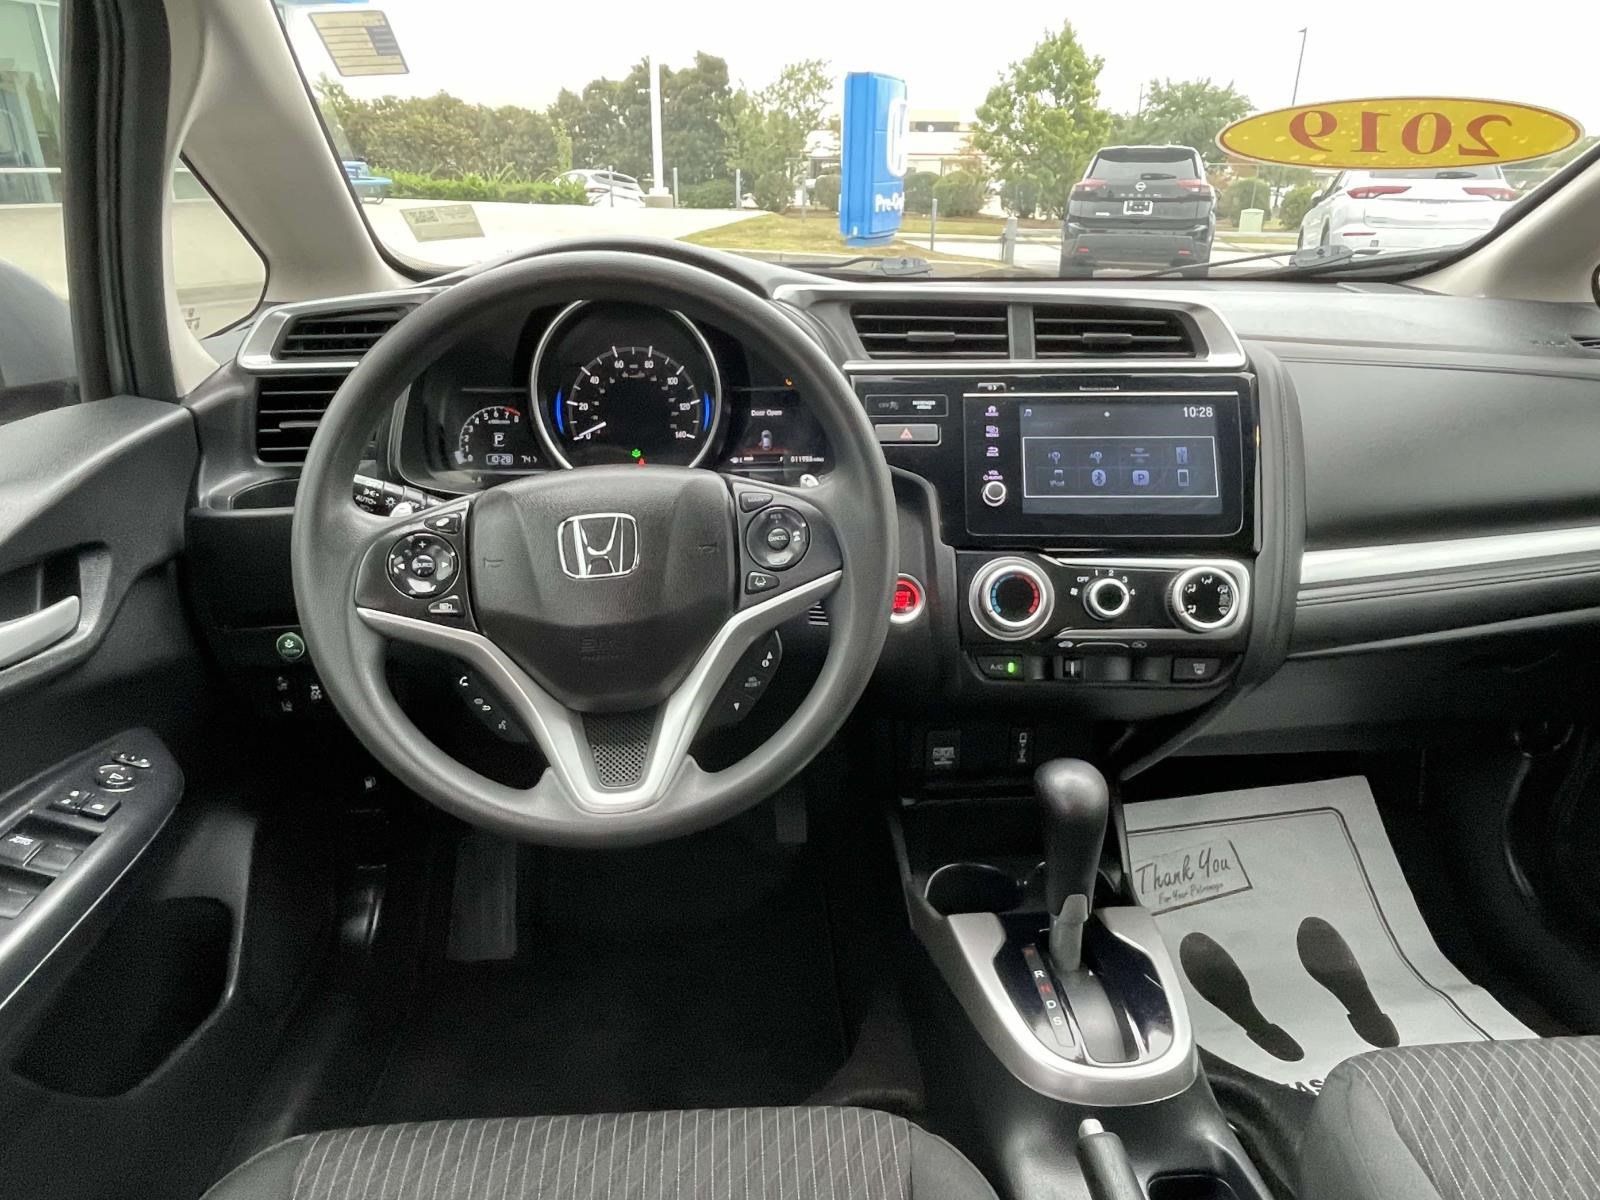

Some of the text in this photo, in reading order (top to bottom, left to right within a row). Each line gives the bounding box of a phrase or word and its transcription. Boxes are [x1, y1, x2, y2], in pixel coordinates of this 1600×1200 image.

[614, 360, 624, 368] 60
[644, 360, 654, 368] 80
[590, 376, 600, 384] 40
[667, 377, 679, 385] 100
[579, 403, 589, 411] 20
[680, 403, 691, 411] 120
[1184, 406, 1213, 417] 10:28
[675, 431, 687, 439] 140
[494, 435, 504, 445] P
[1135, 847, 1231, 894] Thank You
[1033, 970, 1045, 978] R
[1046, 1000, 1057, 1009] D
[1052, 1017, 1062, 1025] S
